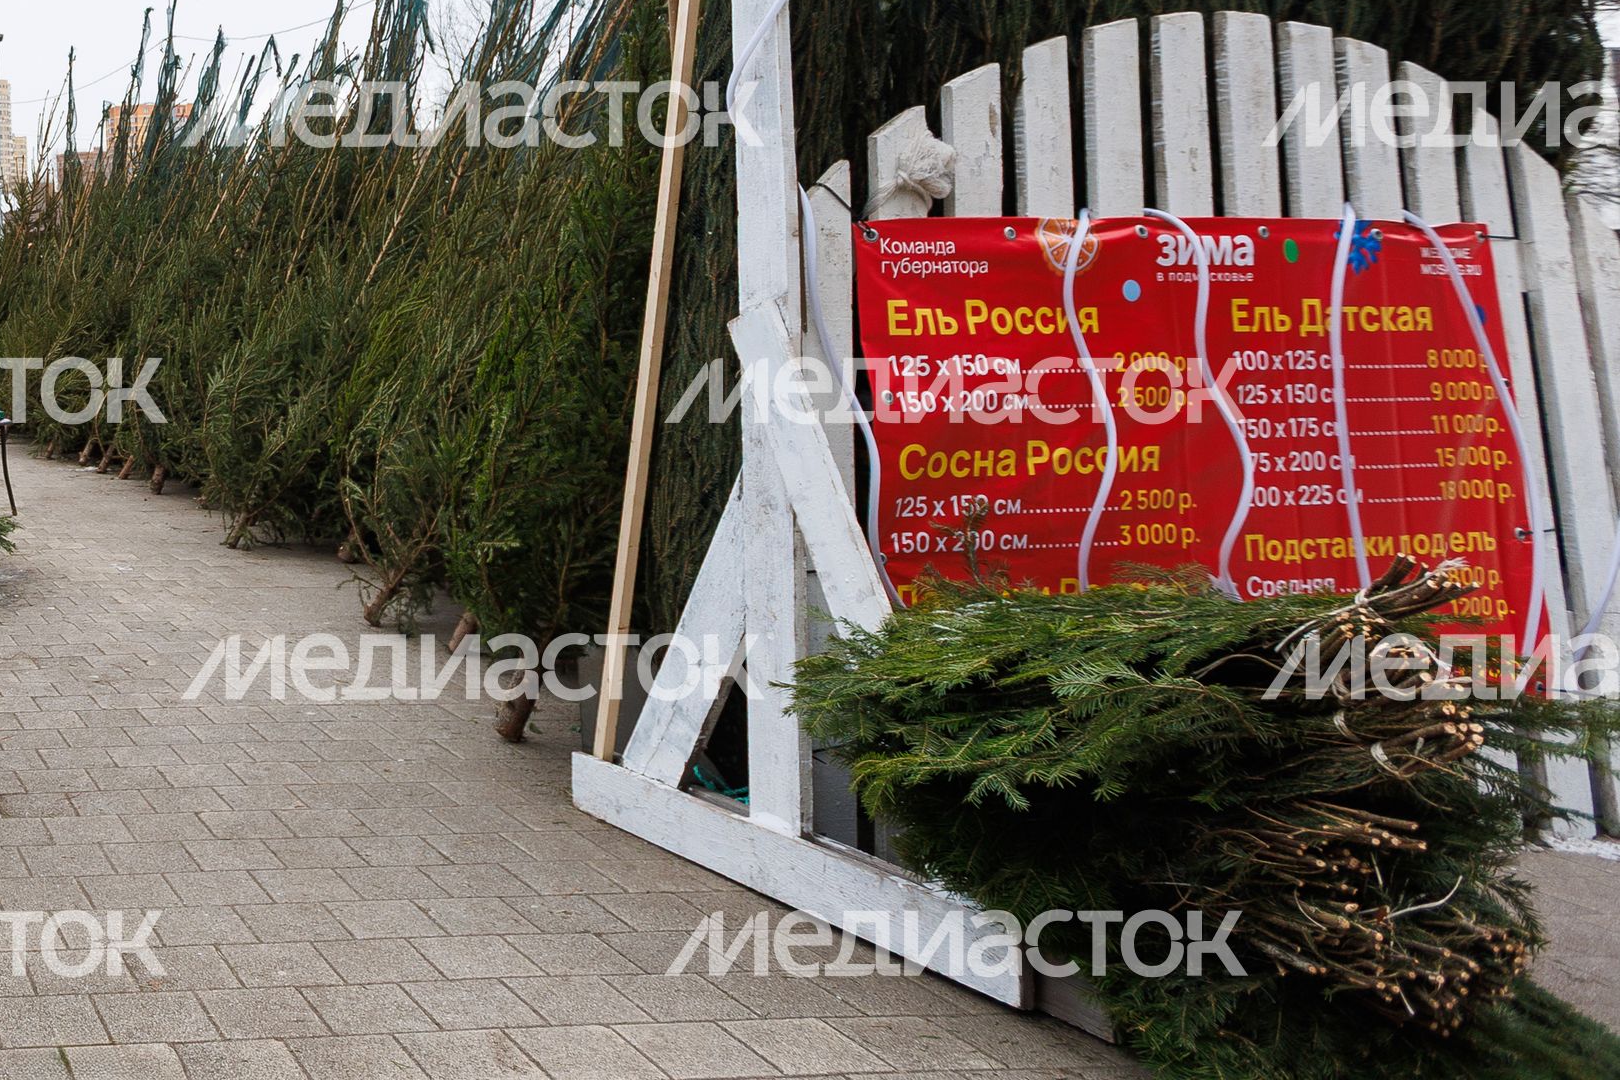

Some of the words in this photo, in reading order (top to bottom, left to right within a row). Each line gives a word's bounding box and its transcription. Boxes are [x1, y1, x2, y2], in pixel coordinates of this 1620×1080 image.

[880, 237, 956, 255] Команда
[1156, 234, 1256, 267] зима
[881, 257, 989, 278] губернатора
[1156, 272, 1165, 283] в
[1169, 271, 1255, 283] подмсковье
[886, 299, 960, 336] Ель
[965, 299, 1100, 335] Россия
[1231, 298, 1292, 333] Ель
[888, 354, 931, 377] 125
[952, 354, 989, 376] 150
[1232, 350, 1270, 371] 100
[1284, 350, 1318, 370] 125
[896, 390, 937, 413] 150
[960, 390, 998, 411] 200
[1237, 384, 1269, 404] 125
[1285, 383, 1318, 403] 150
[1288, 417, 1320, 437] 175
[899, 443, 1017, 481] Сосна
[1026, 440, 1161, 475] Россия
[1250, 452, 1271, 473] 75
[1288, 451, 1327, 471] 200
[895, 496, 928, 517] 125
[950, 494, 989, 517] 150
[1249, 486, 1281, 507] 00
[1297, 485, 1334, 505] 225
[890, 532, 930, 554] 150
